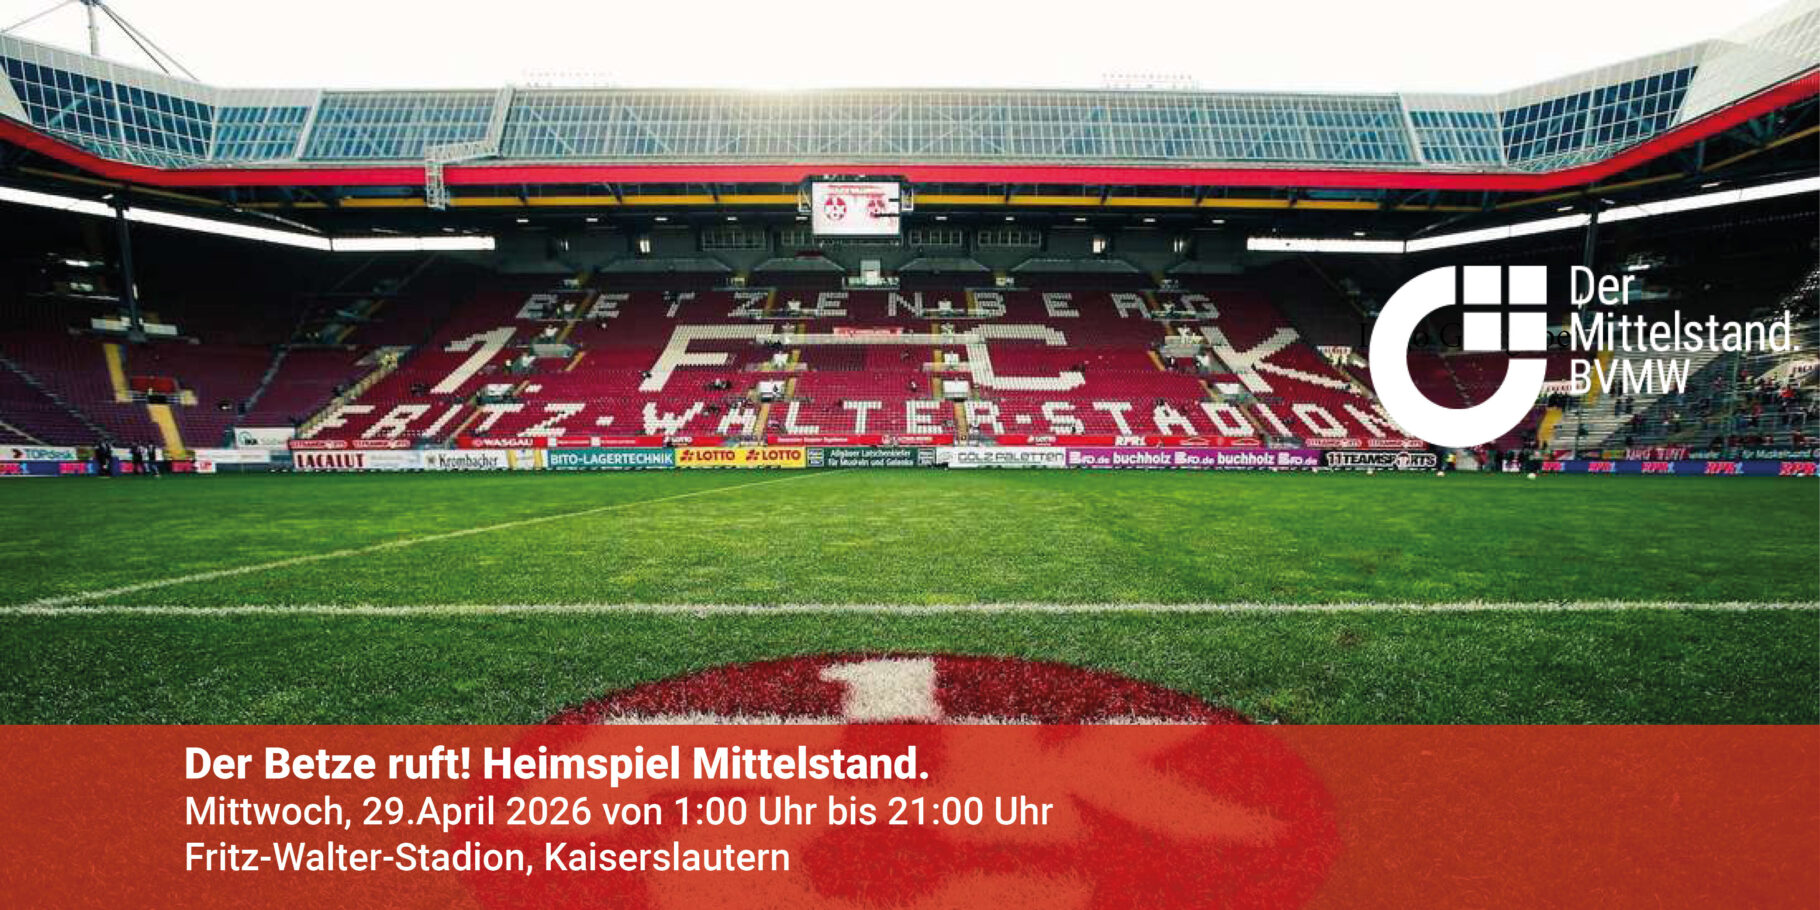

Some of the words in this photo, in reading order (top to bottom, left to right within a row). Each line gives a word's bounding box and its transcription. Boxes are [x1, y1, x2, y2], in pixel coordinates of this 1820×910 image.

[296, 453, 364, 467] LACALUT
[438, 451, 499, 467] Krombacher
[550, 452, 674, 465] BITO-LAGERTECHNIK
[696, 450, 735, 461] LOTTO
[762, 449, 801, 461] LOTTO
[1113, 451, 1171, 465] buchholz
[1217, 451, 1275, 466] buchholz
